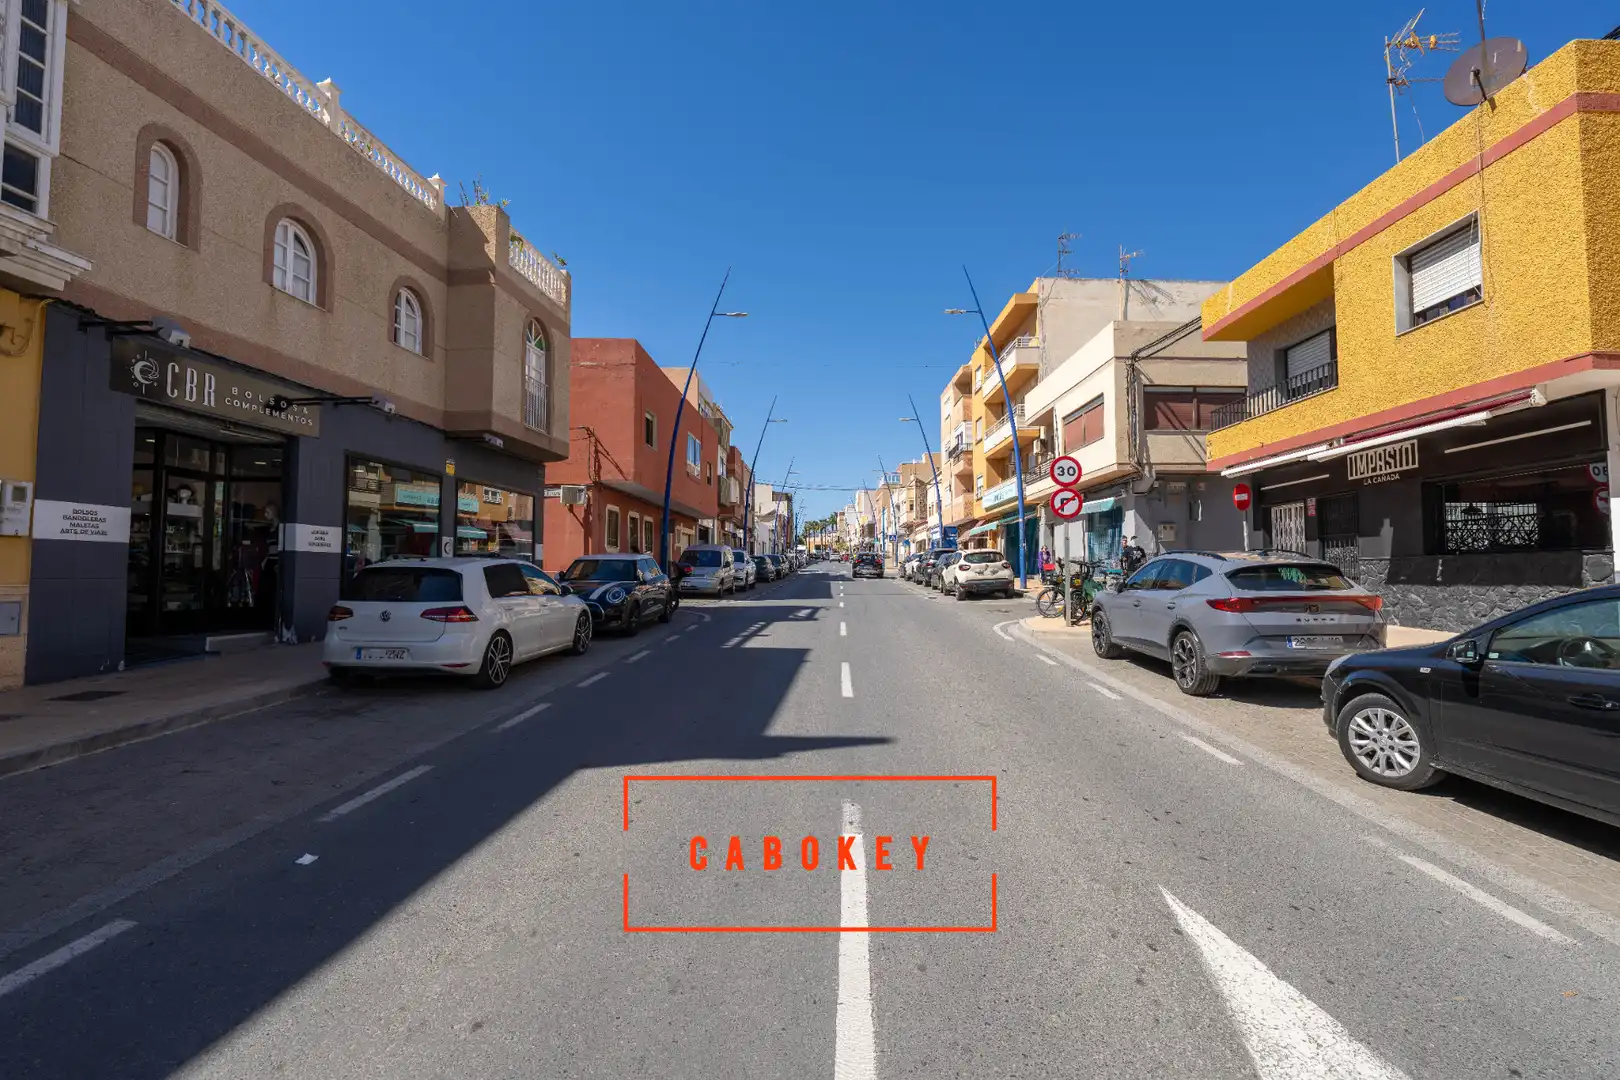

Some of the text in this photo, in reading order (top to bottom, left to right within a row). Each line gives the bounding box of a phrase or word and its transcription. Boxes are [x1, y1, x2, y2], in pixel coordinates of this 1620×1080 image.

[166, 362, 216, 408] CBR
[224, 397, 313, 427] COMPLEMENTOS
[1056, 466, 1077, 477] 30
[1351, 443, 1413, 478] IMPASTO
[1363, 473, 1401, 486] LA CAÑADA
